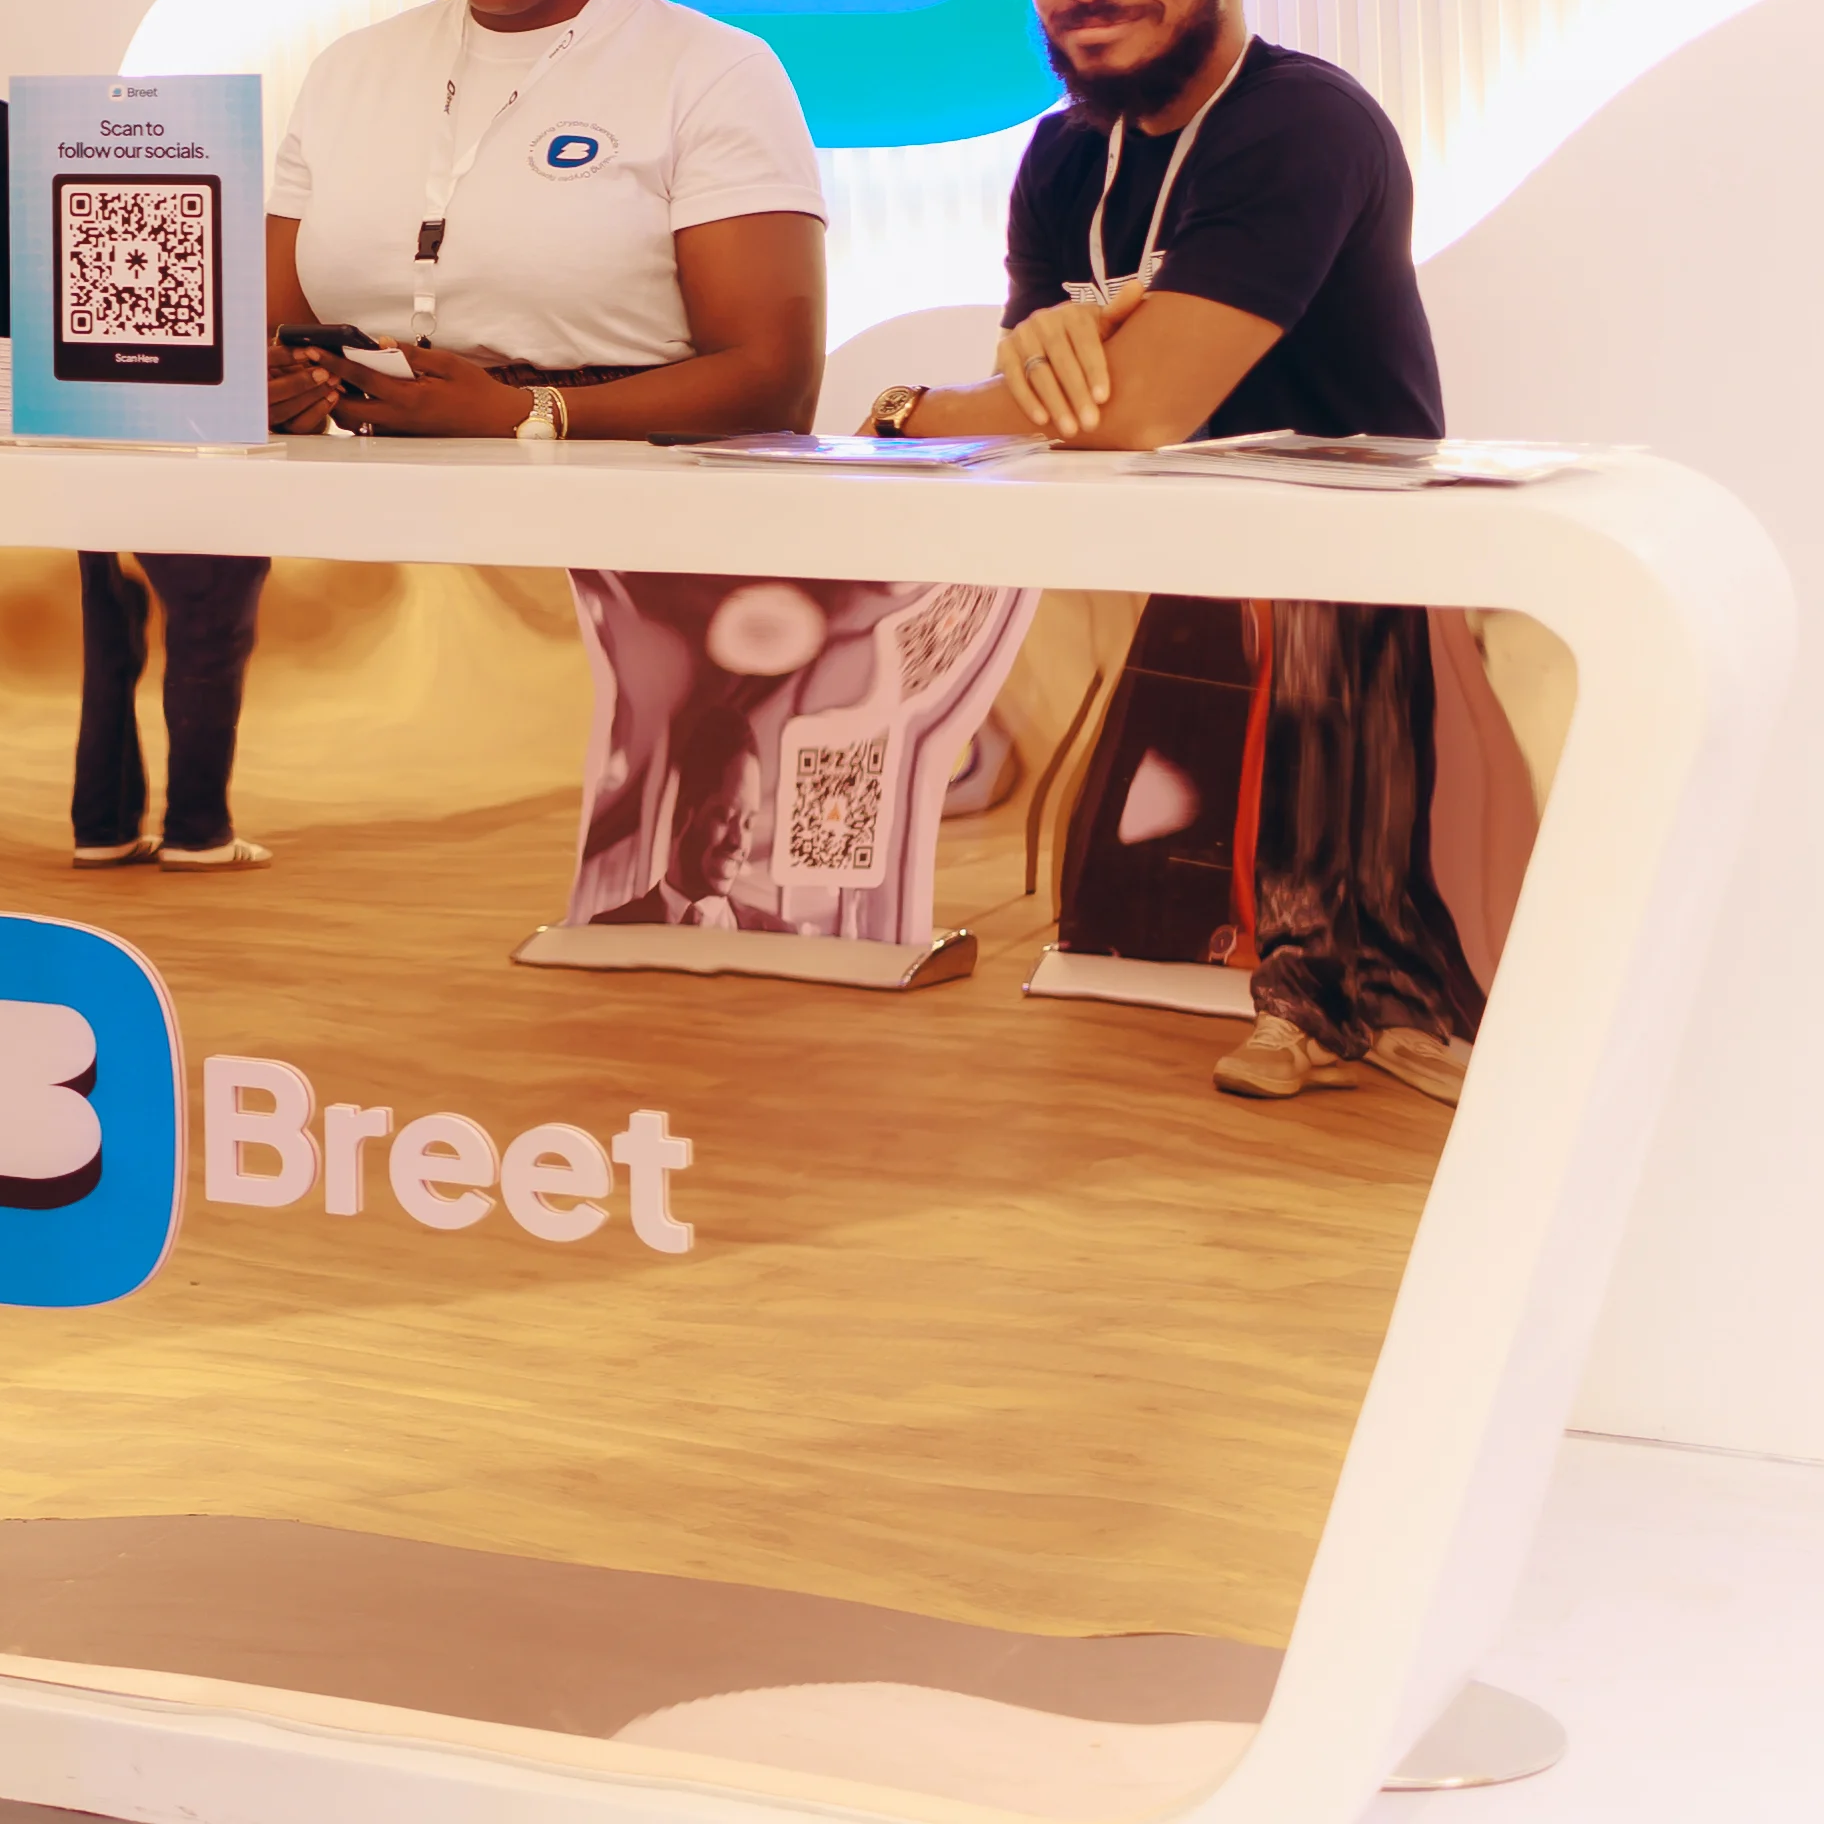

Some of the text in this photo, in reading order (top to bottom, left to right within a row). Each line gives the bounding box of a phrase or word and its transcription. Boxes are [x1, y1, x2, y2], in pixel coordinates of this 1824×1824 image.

[127, 87, 158, 98] Breet
[100, 119, 165, 137] Scan to
[57, 141, 210, 159] follow our socials.
[115, 352, 160, 364] Scan Here
[204, 1054, 694, 1254] Breet
